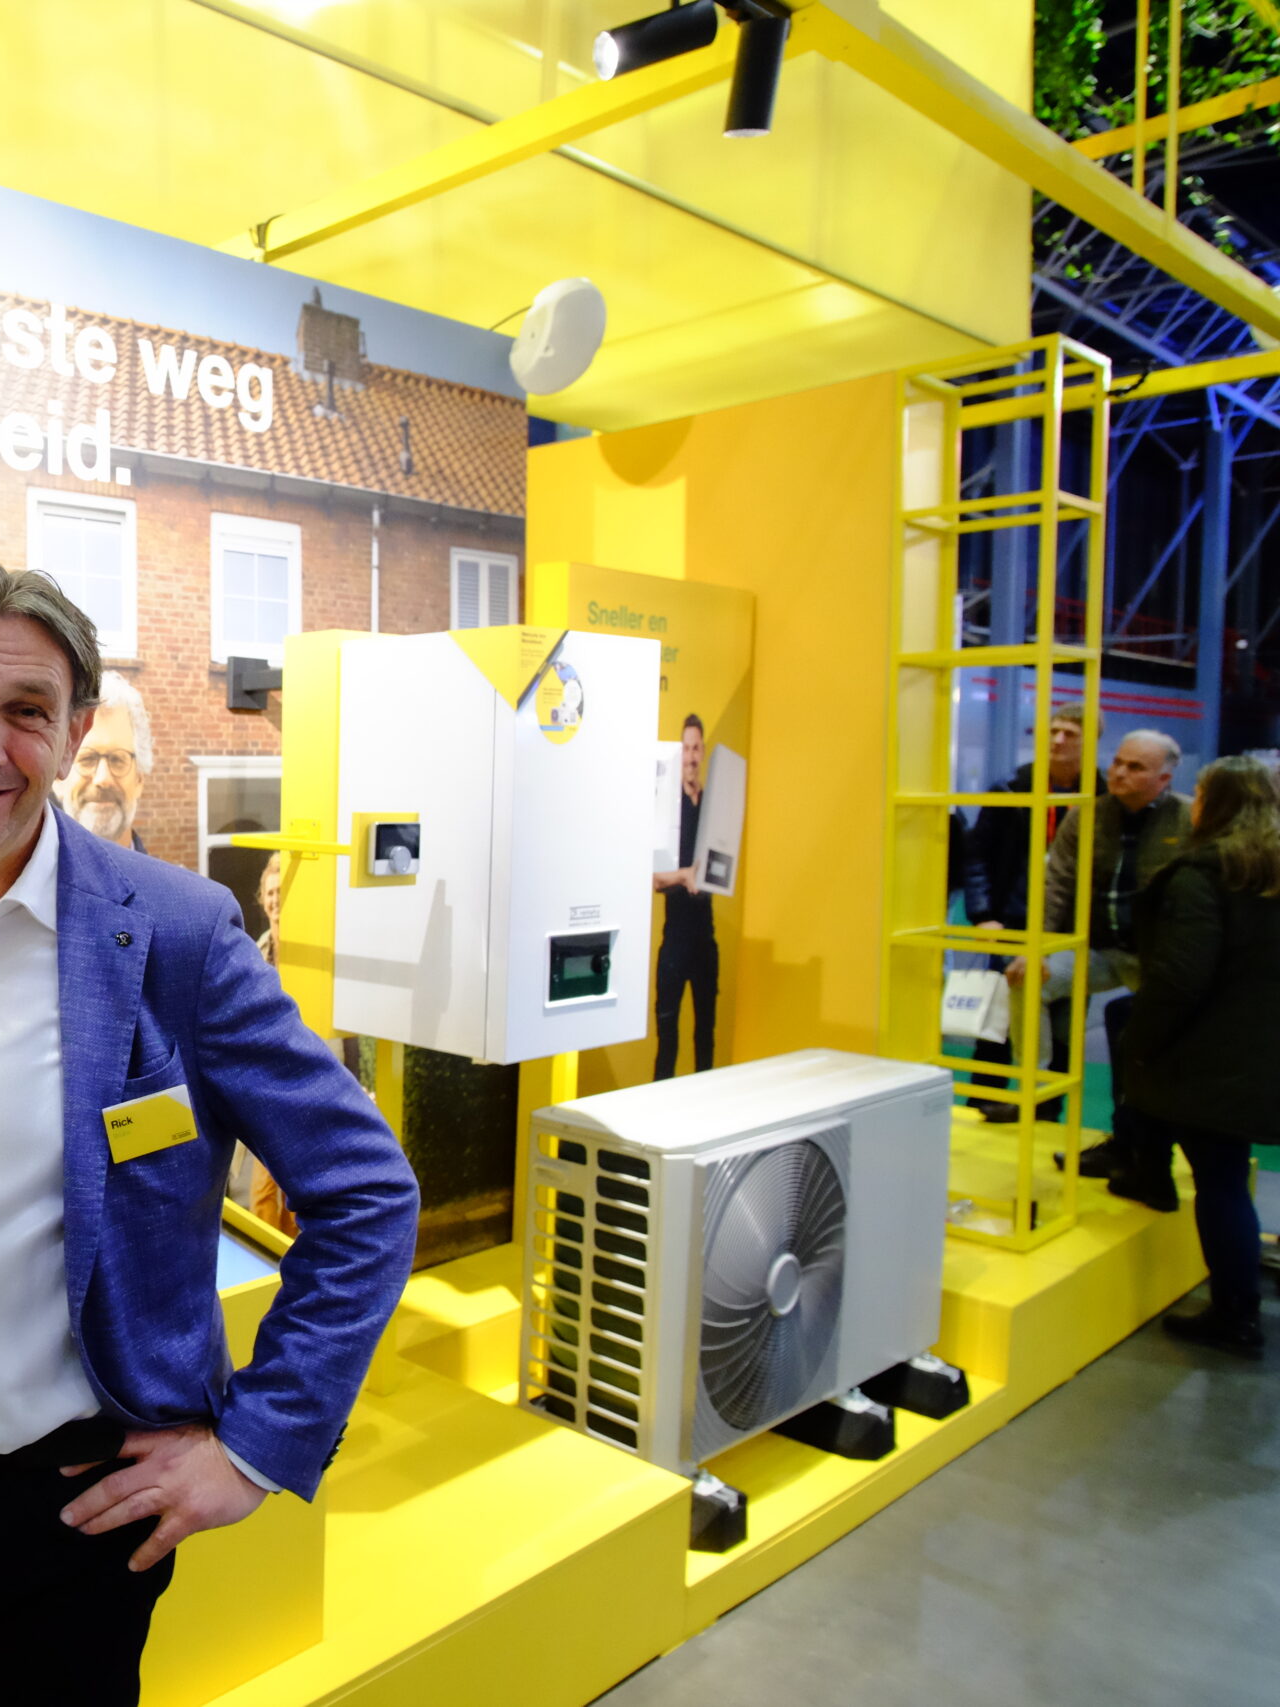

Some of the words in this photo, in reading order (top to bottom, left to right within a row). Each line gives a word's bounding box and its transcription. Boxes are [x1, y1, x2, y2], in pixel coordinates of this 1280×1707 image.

[137, 338, 274, 432] weg
[587, 601, 644, 630] Sneller
[648, 614, 668, 633] en
[110, 1117, 134, 1130] Rick
